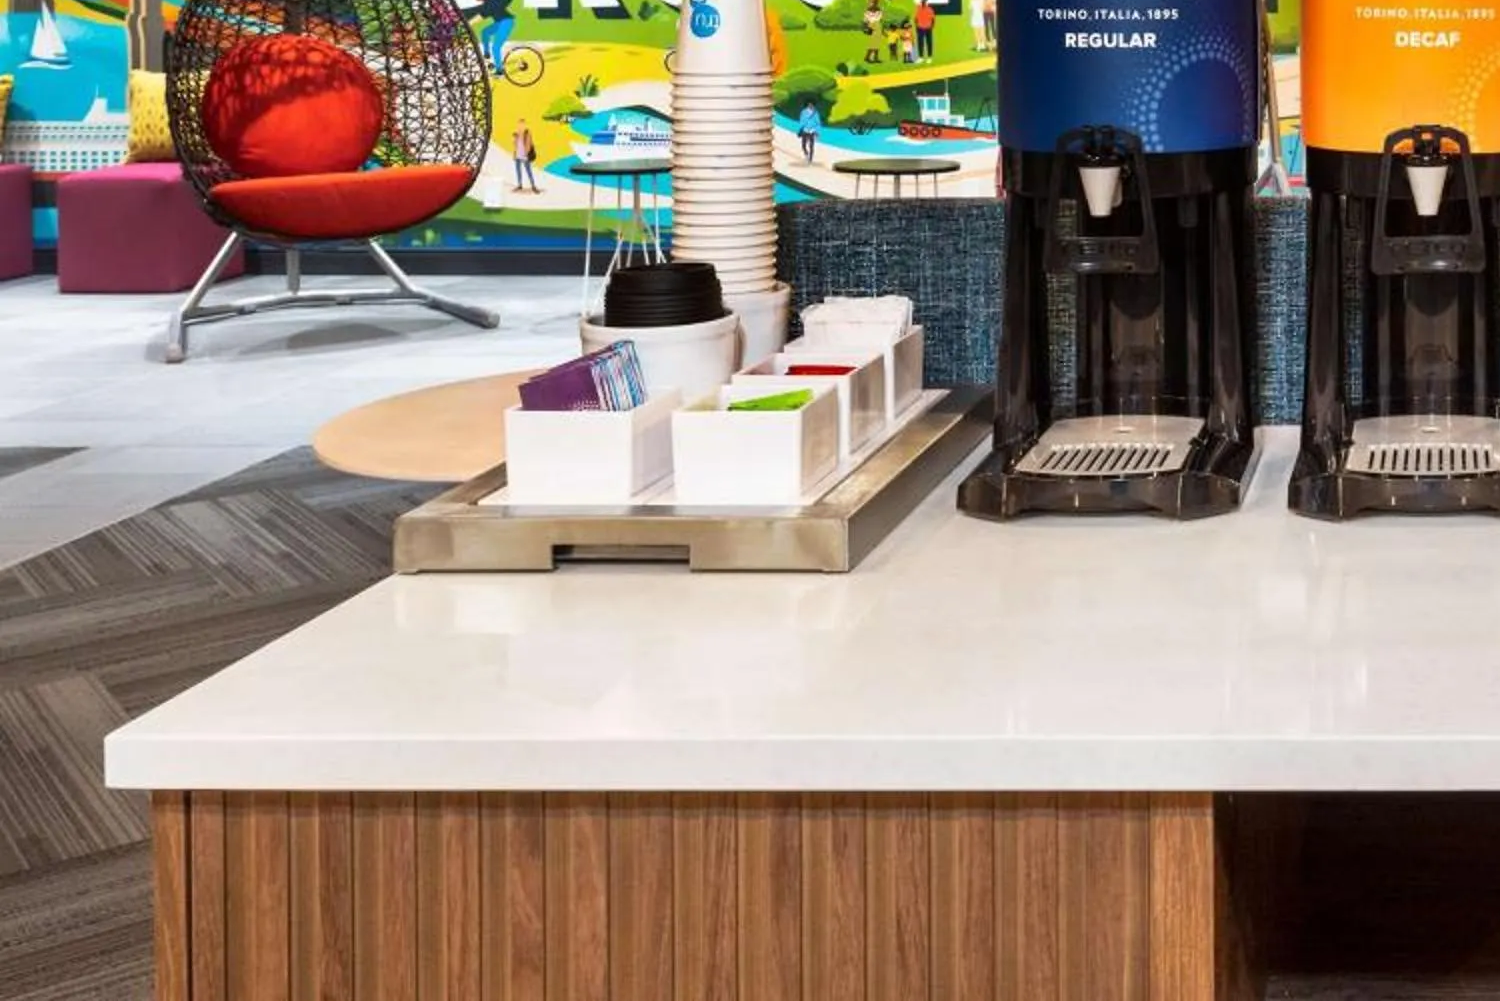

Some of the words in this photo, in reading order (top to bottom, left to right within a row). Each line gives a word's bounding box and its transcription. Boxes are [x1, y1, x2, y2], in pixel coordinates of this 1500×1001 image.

[1147, 8, 1180, 20] 1895
[1065, 32, 1157, 48] REGULAR
[1395, 31, 1461, 48] DECAF
